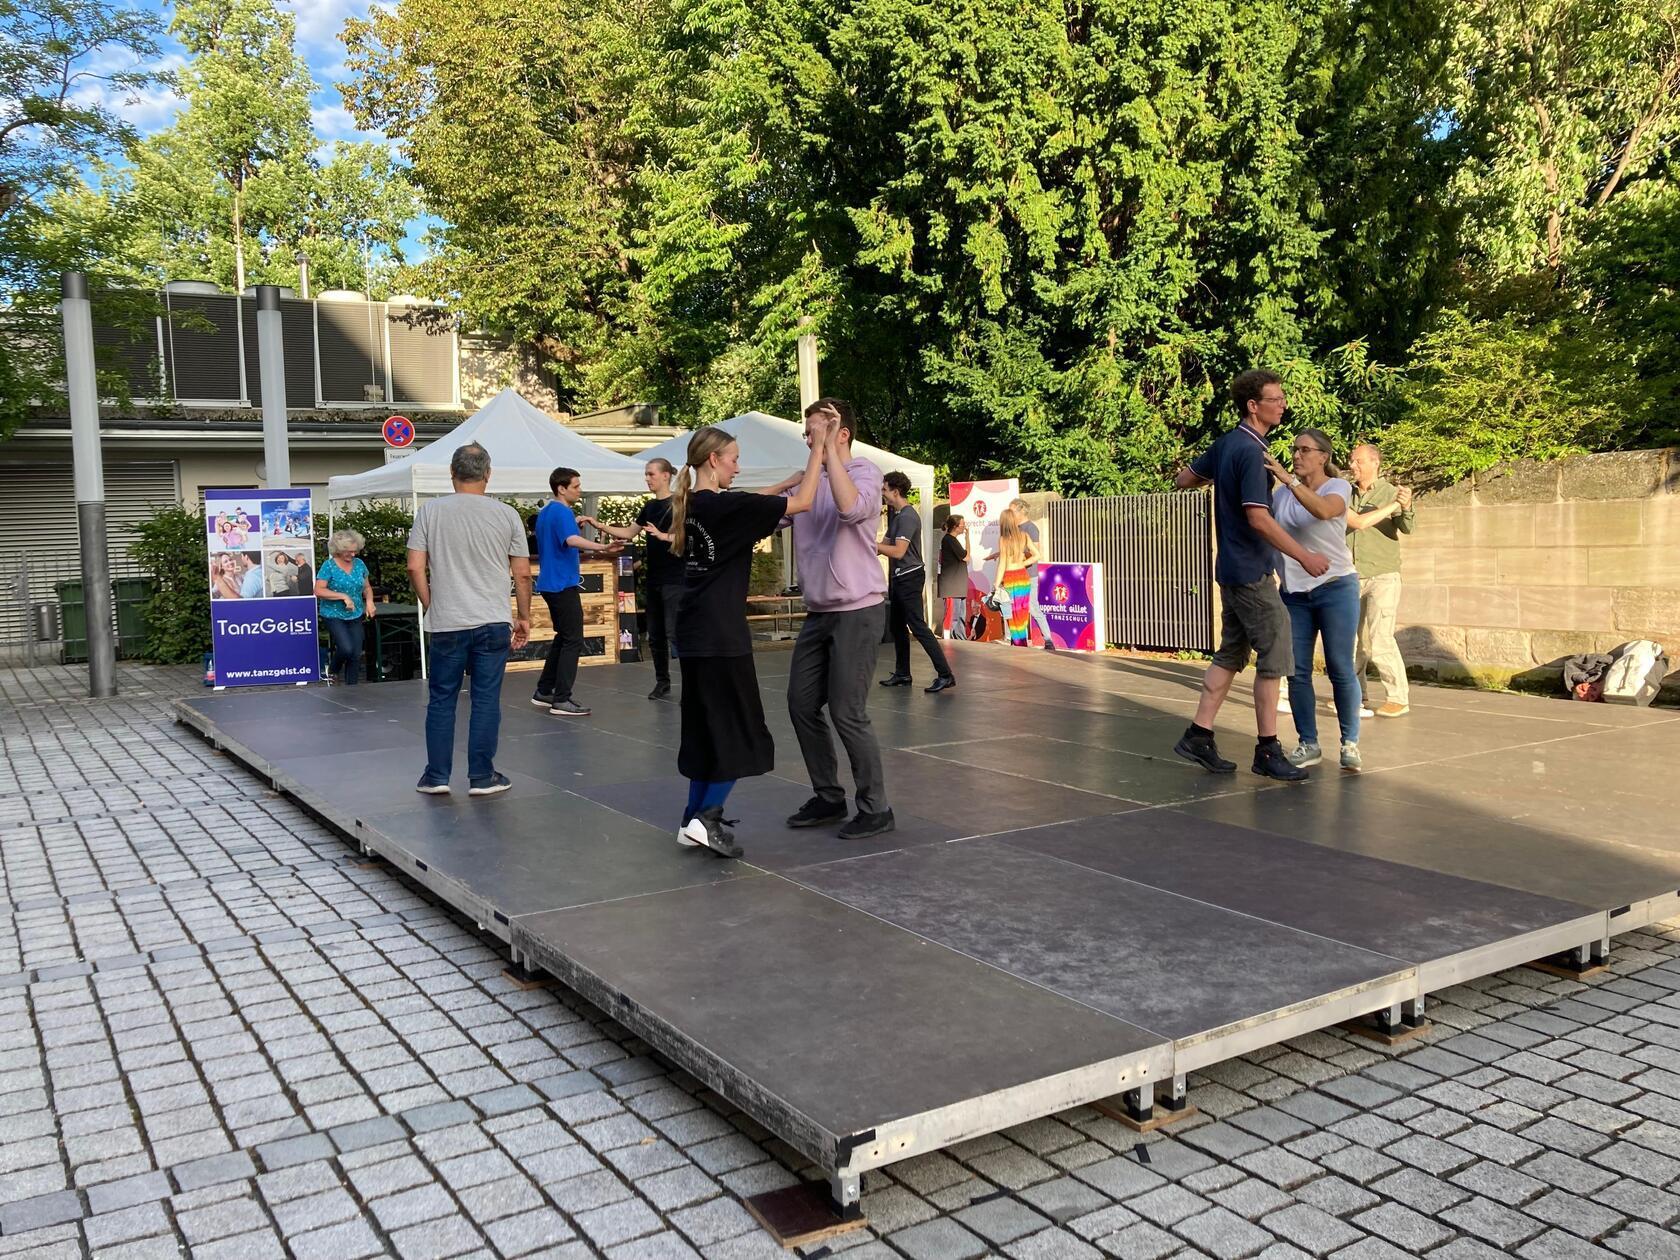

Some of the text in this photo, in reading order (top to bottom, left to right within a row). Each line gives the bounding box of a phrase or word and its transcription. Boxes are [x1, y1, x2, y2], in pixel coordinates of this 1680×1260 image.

[1050, 614, 1088, 623] TANZSCHULE
[217, 618, 312, 635] TanzGeist
[226, 667, 312, 678] www.tanzgeist.de
